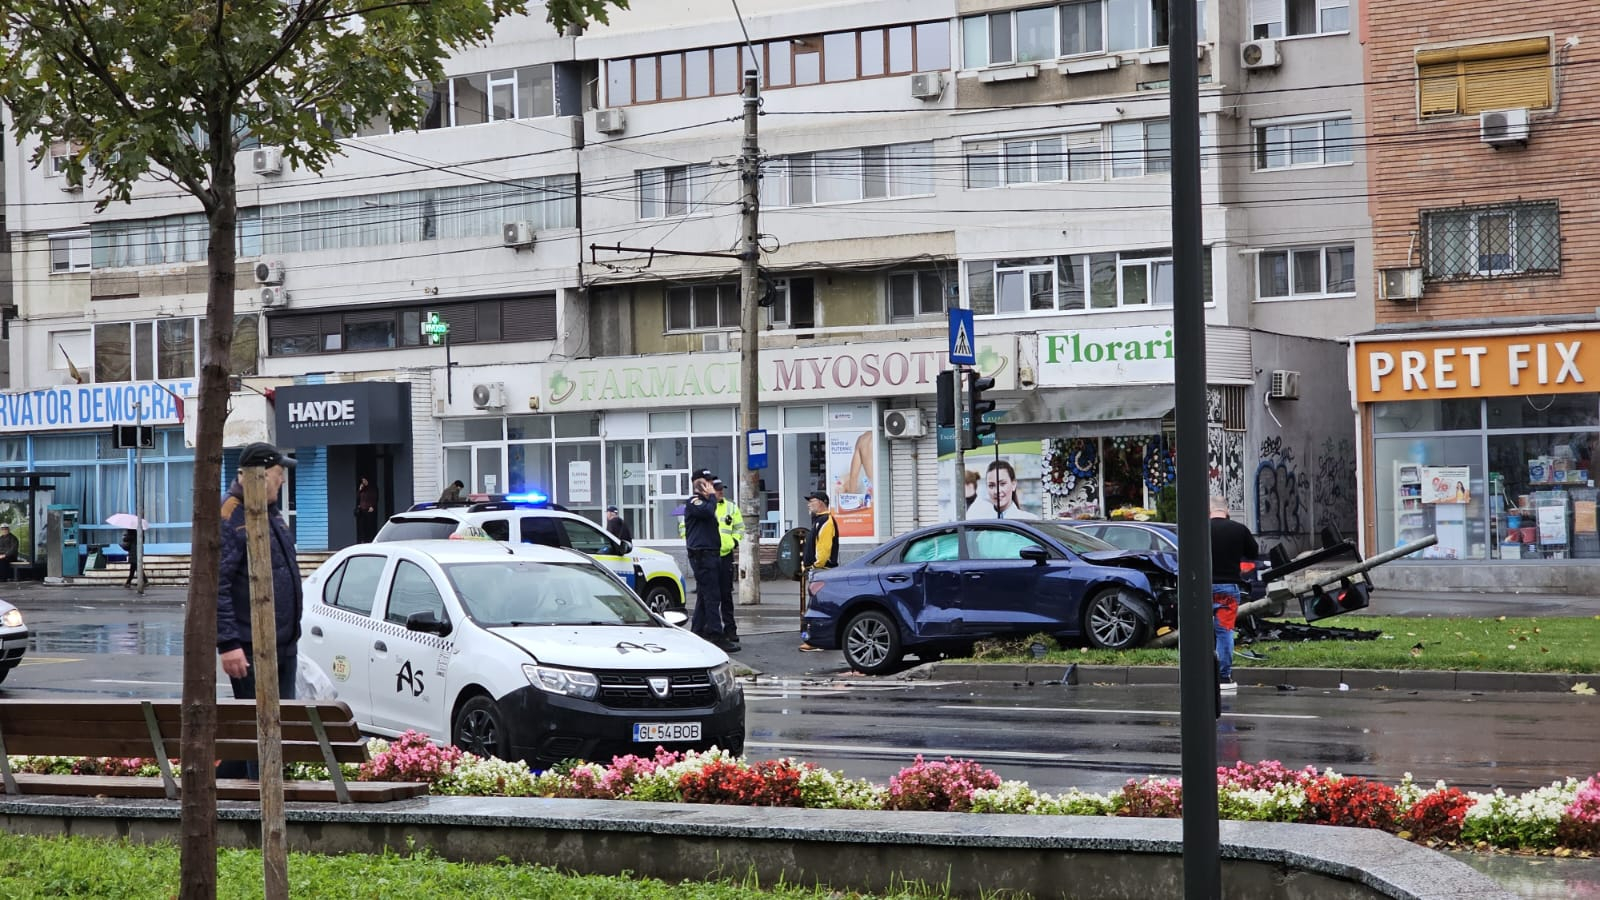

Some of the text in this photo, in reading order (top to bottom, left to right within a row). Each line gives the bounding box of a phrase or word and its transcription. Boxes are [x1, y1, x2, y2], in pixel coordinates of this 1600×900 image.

[579, 350, 972, 401] FARMACI MYOSOTI
[1370, 341, 1584, 392] PRET FIX
[79, 382, 192, 424] DEMOCRAT
[288, 400, 355, 422] HAYDE
[639, 725, 700, 739] GL 54 BOB
